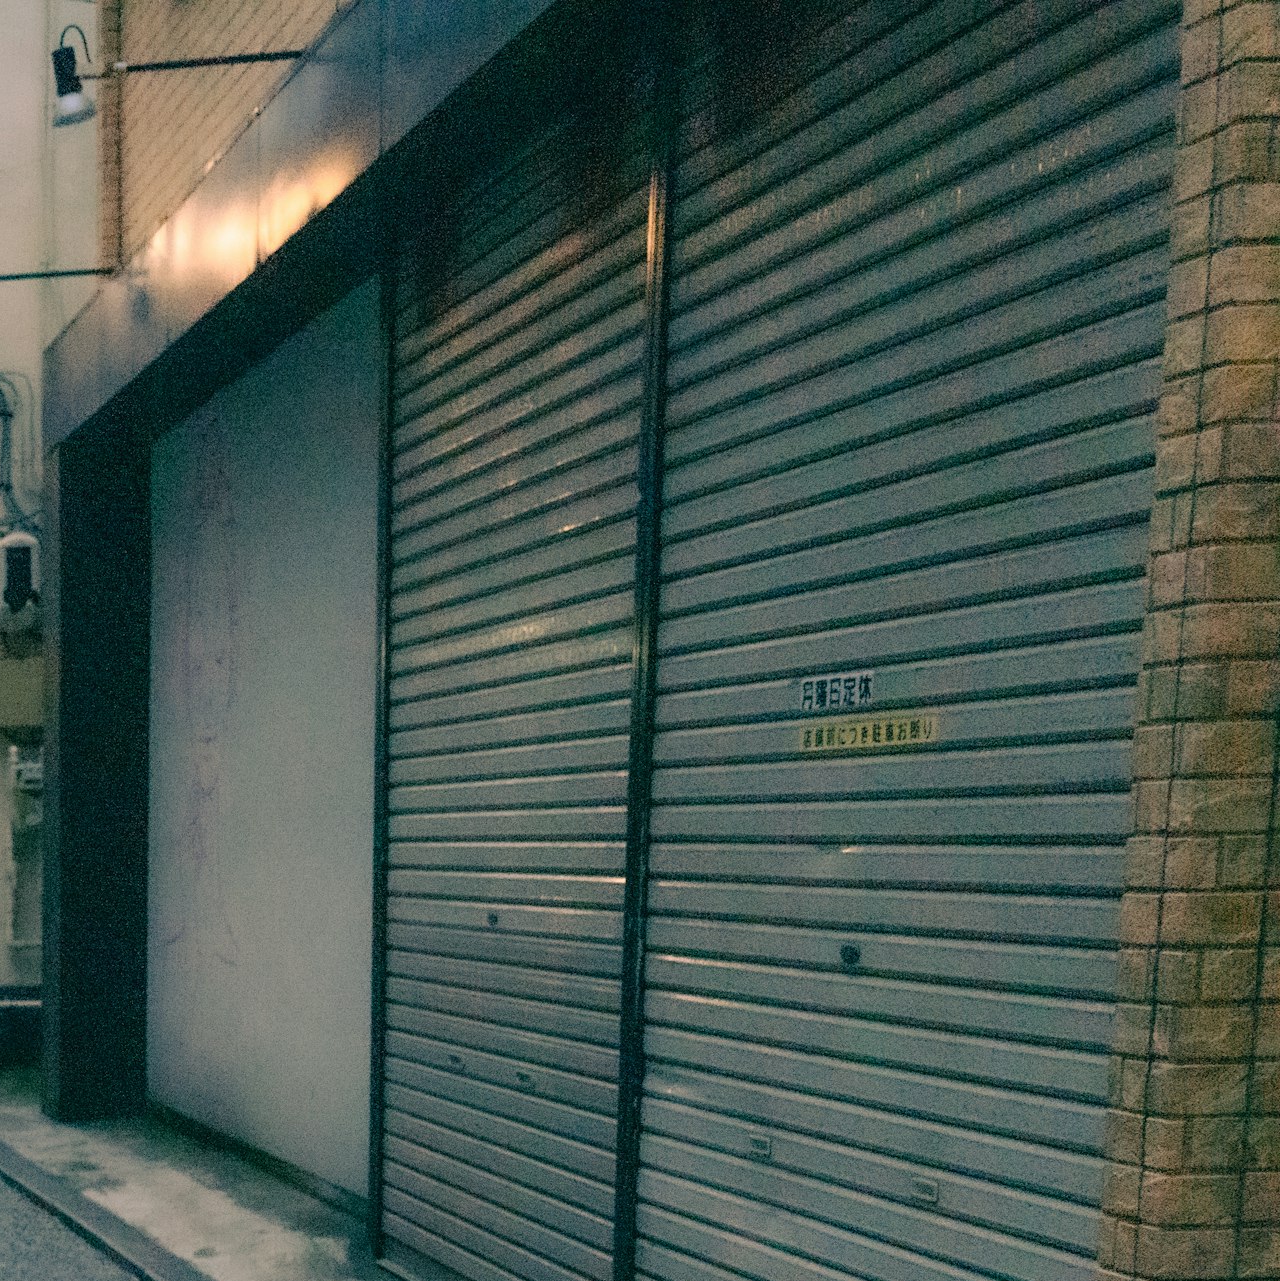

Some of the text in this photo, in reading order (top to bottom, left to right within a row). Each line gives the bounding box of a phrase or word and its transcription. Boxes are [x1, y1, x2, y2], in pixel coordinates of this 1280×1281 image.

[801, 674, 872, 711] 月曜日定休
